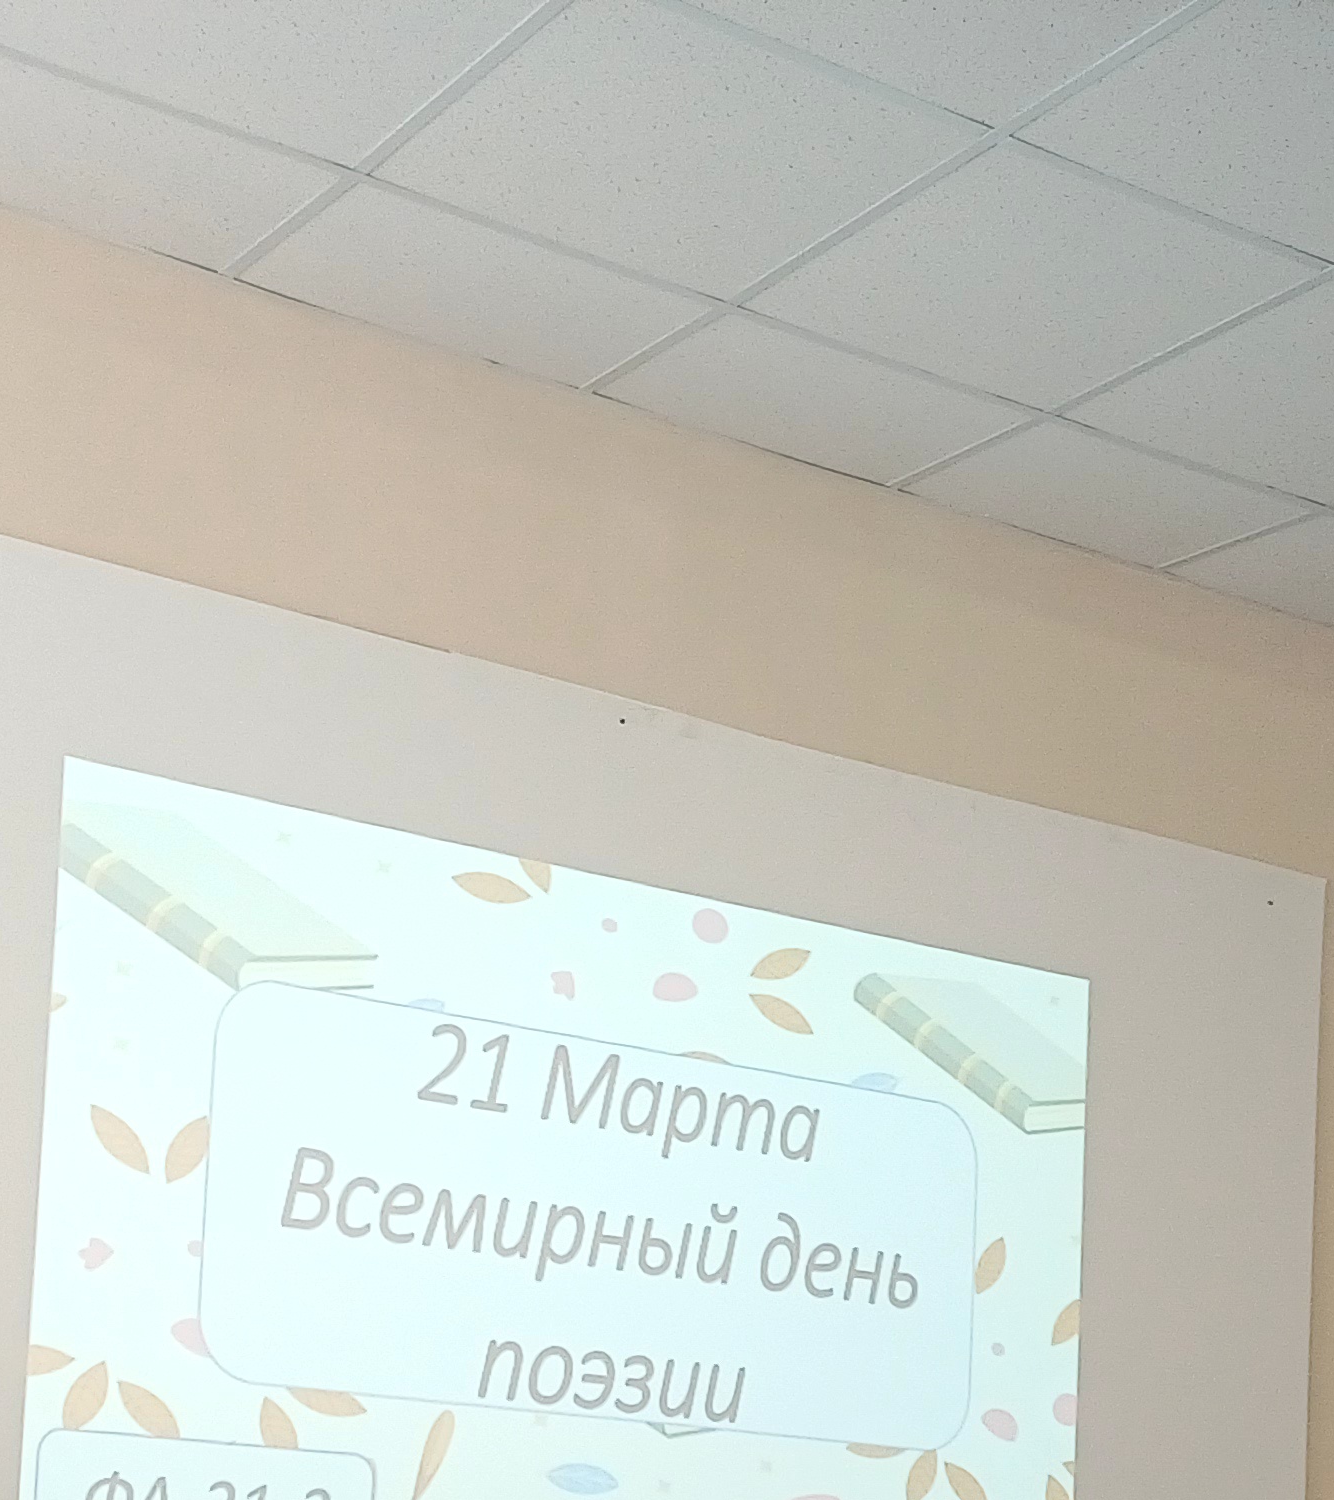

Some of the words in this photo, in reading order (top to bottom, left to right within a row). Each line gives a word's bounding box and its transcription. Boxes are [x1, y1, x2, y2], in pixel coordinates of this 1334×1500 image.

[417, 1023, 510, 1113] 21
[540, 1044, 820, 1163] Марта
[281, 1146, 738, 1283] Всемирный
[759, 1212, 918, 1309] день
[477, 1339, 745, 1423] поэзии
